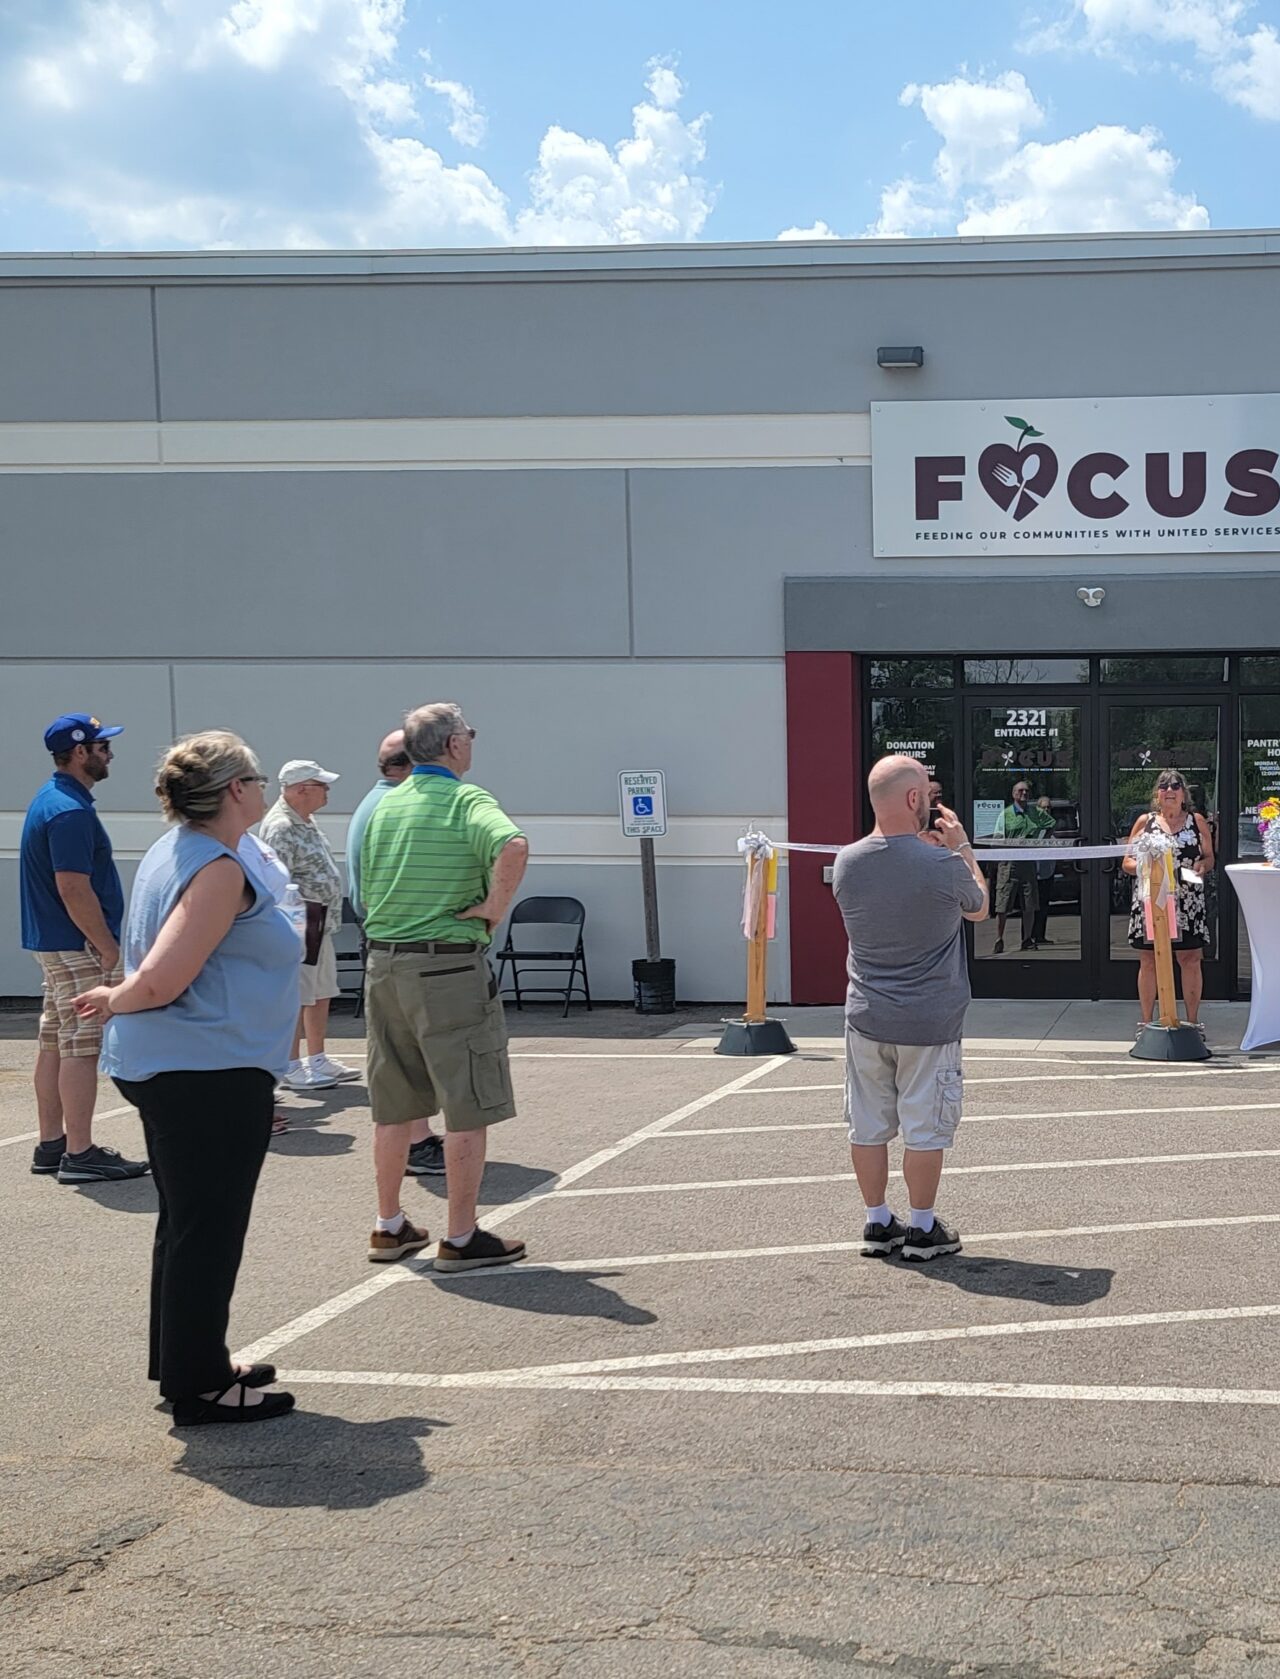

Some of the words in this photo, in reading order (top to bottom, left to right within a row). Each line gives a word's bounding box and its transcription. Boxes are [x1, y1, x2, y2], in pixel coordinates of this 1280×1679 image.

[915, 532, 973, 541] FEEDING
[979, 531, 1007, 540] OUR
[1013, 530, 1109, 540] COMMUNITIES
[1115, 529, 1151, 538] WITH
[1157, 528, 1208, 537] UNITED
[1006, 709, 1046, 726] 2321
[994, 728, 1047, 737] ENTRANCE
[1048, 728, 1059, 737] #1
[886, 741, 935, 750] DONATION
[624, 776, 657, 785] RESERVED
[628, 787, 655, 795] PARKING
[642, 825, 663, 833] SPACE
